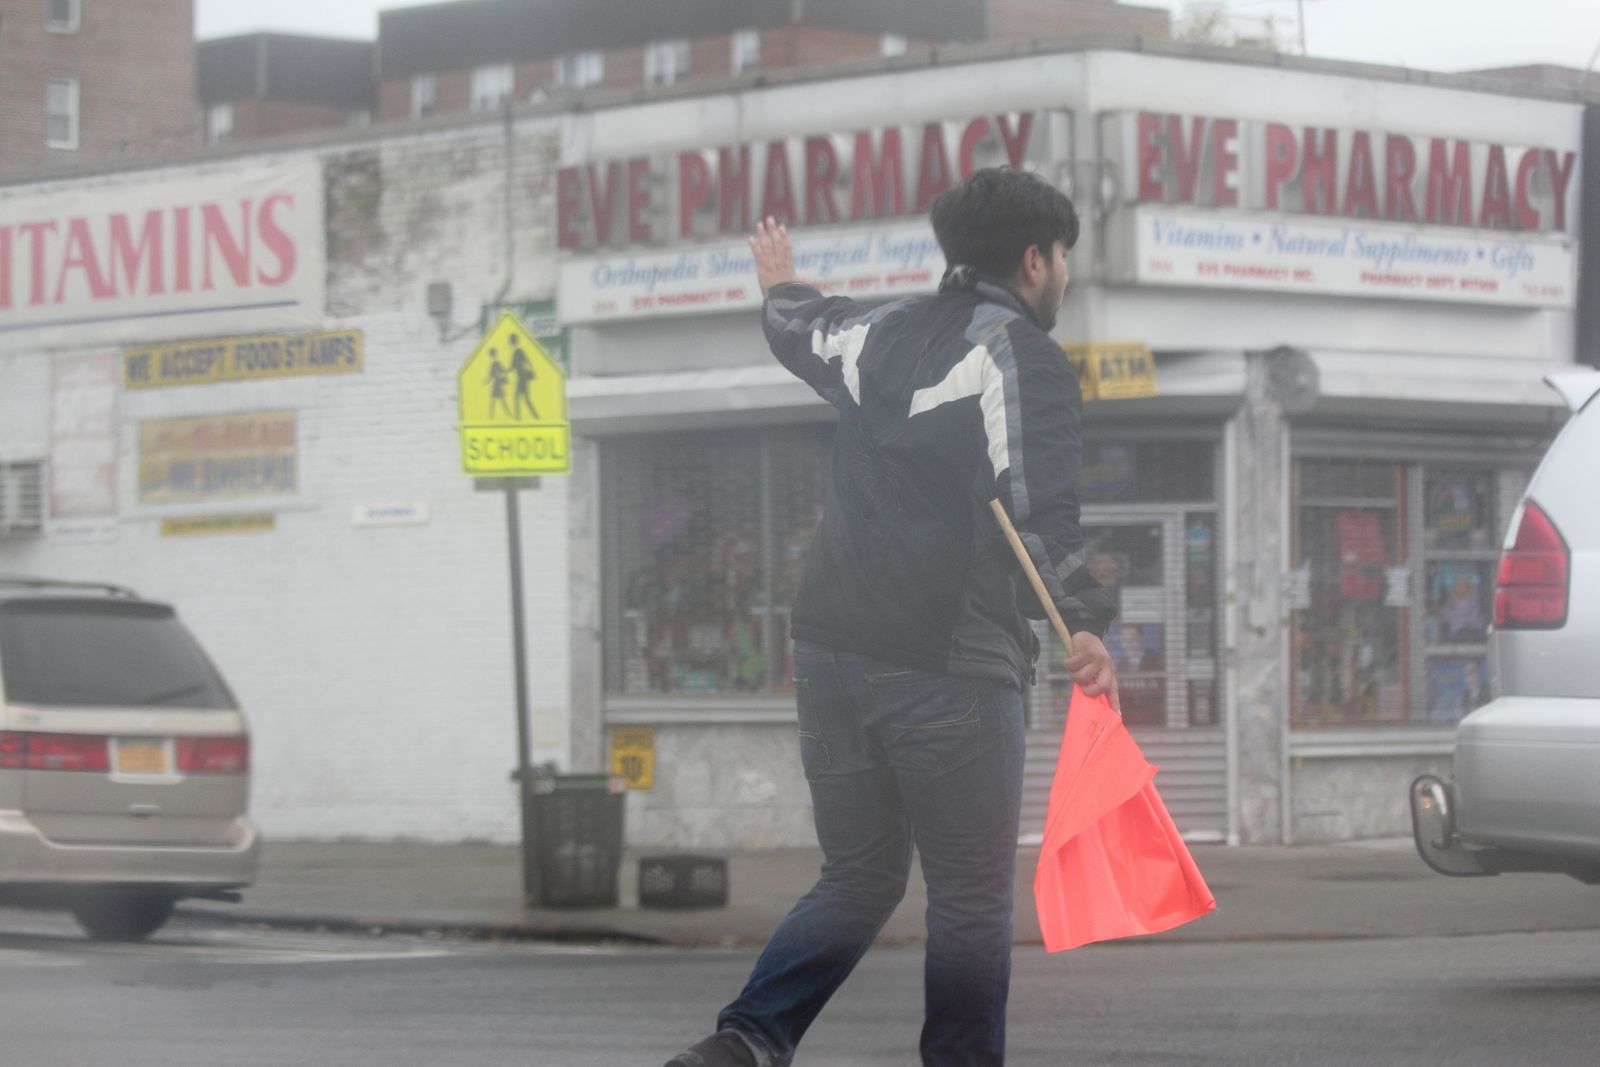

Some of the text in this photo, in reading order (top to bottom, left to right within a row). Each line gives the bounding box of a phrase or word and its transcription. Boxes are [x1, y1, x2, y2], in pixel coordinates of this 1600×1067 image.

[1137, 111, 1576, 232] EVE PHARMACY
[557, 158, 653, 250] EVE
[1152, 216, 1244, 253] Vitamins
[1267, 225, 1349, 257] Natural
[1491, 240, 1535, 279] Gifts
[592, 252, 699, 291] Orthopedic
[127, 352, 150, 383] WE
[160, 345, 227, 380] ACCEPT
[1100, 355, 1148, 382] ATM
[468, 437, 564, 461] SCHOOL
